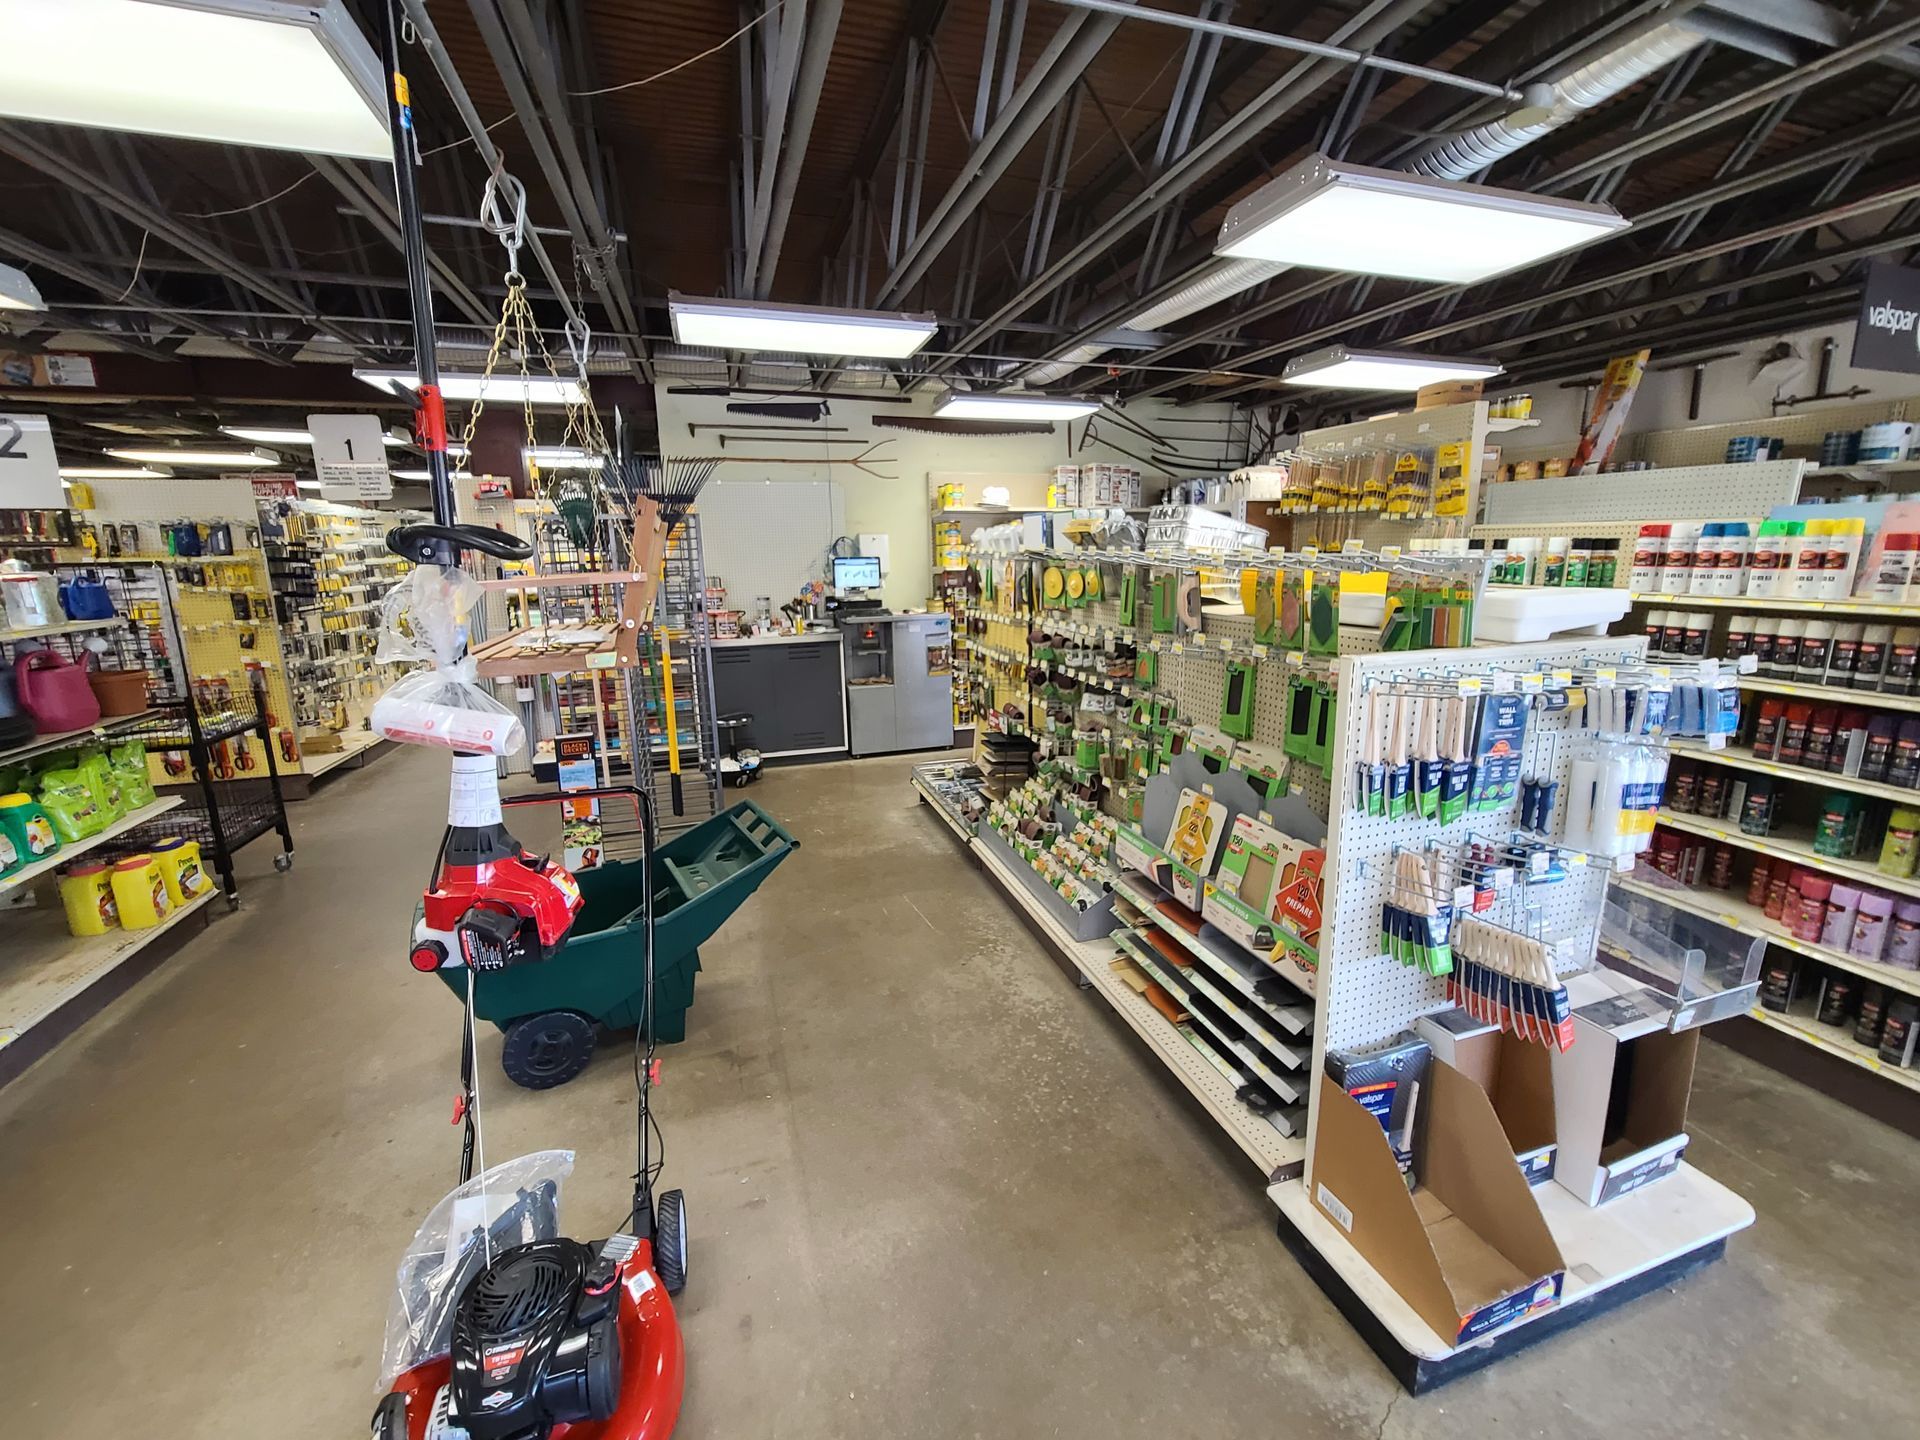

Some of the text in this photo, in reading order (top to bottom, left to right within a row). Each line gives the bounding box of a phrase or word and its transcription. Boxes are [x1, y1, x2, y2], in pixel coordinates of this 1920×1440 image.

[1870, 300, 1918, 335] valspar
[0, 418, 28, 459] 2
[344, 439, 353, 460] 1
[253, 488, 286, 496] SUPPLIES
[1499, 706, 1516, 714] WALL
[1498, 718, 1514, 726] TRIM
[1232, 834, 1243, 847] 150
[178, 856, 194, 868] Preen
[1297, 884, 1308, 899] 120
[1234, 906, 1249, 920] TOOLS
[1285, 897, 1314, 919] PREPARE
[1359, 1094, 1384, 1104] valspar
